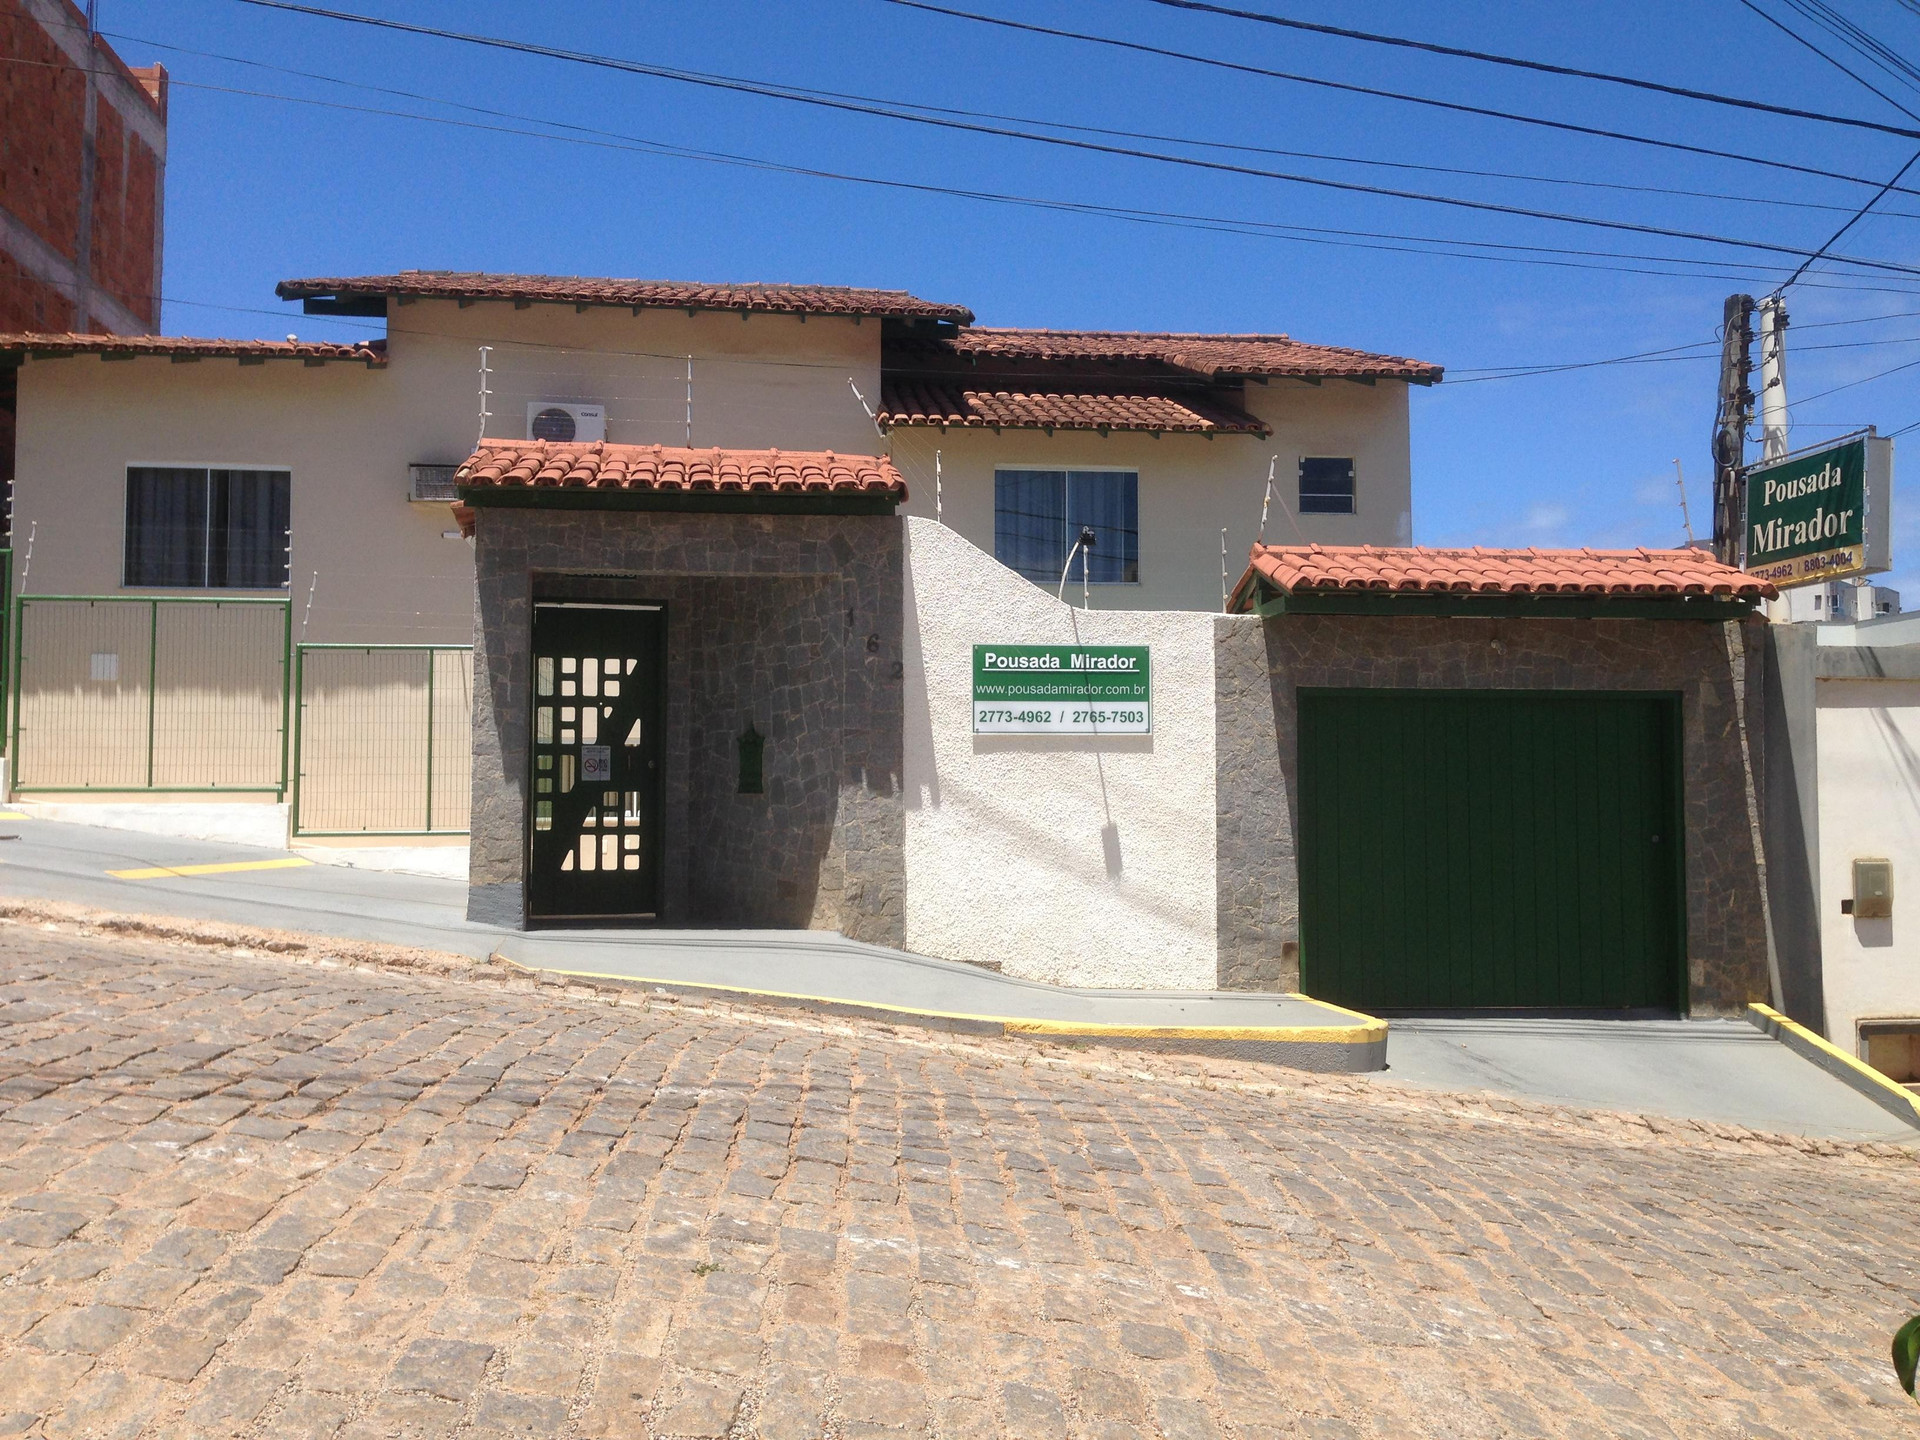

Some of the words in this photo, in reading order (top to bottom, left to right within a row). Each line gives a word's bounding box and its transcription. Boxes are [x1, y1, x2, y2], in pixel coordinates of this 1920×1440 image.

[1763, 462, 1842, 506] Pousada
[1751, 507, 1853, 556] Mirador
[1804, 551, 1853, 572] 8803-4004
[984, 652, 1060, 668] Pousada
[1070, 653, 1137, 669] Mirador
[975, 683, 1146, 697] www.pousadamirador.com.br
[979, 710, 1052, 723] 2773-4962
[1072, 710, 1144, 723] 2765-7503
